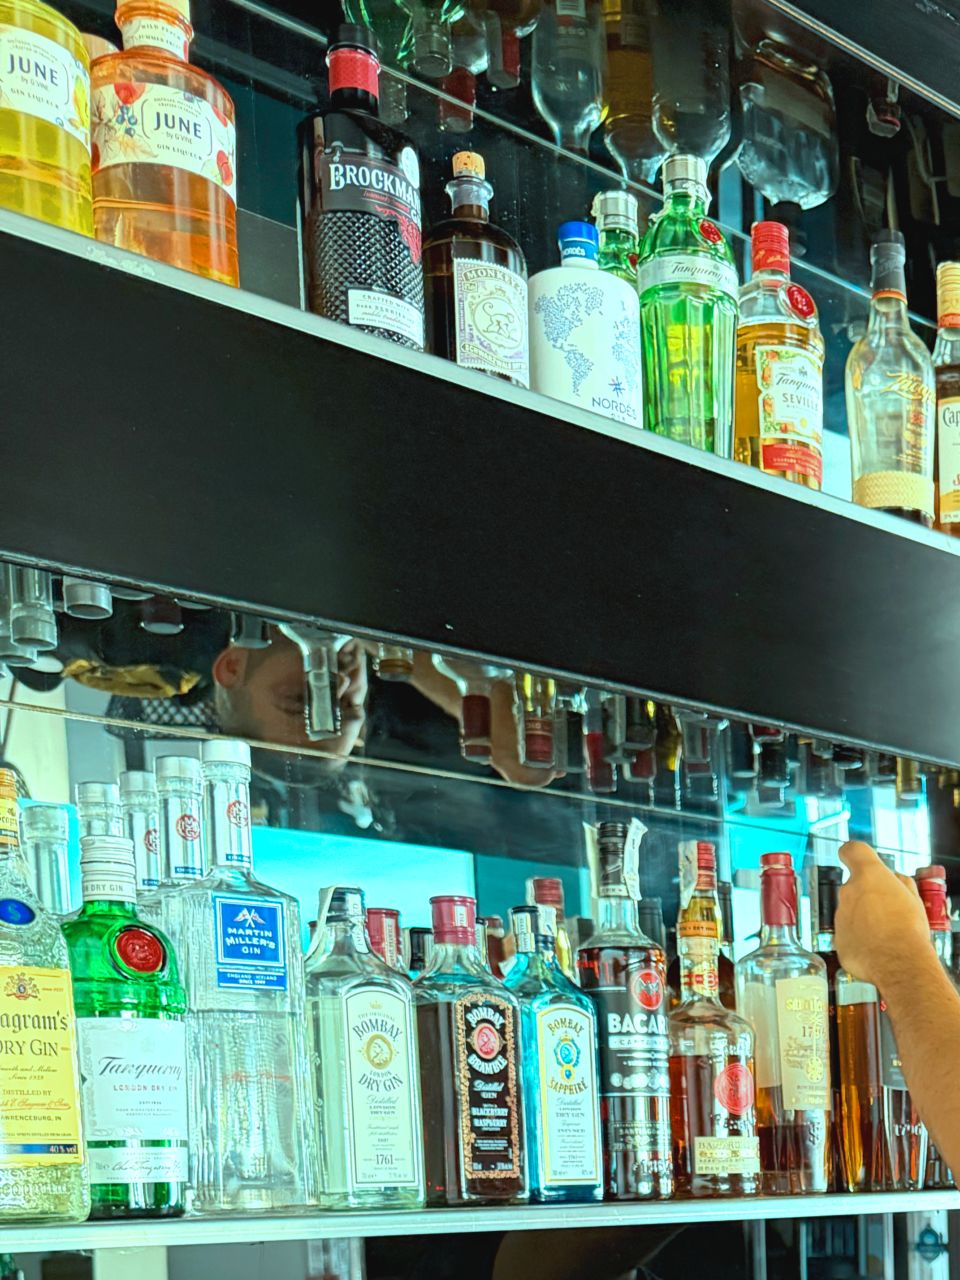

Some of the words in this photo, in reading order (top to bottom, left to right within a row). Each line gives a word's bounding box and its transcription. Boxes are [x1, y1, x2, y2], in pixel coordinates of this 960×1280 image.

[7, 53, 58, 87] JUNE
[154, 111, 202, 140] JUNE
[466, 268, 521, 293] MONKEY
[671, 261, 723, 283] Tanqueray
[363, 294, 393, 305] CRAFTED
[592, 397, 637, 420] NORDÉS
[91, 884, 106, 892] DRY
[109, 884, 124, 892] GIN
[227, 927, 273, 937] MARTIN
[225, 936, 276, 949] MILLER'S
[241, 946, 261, 955] GIN
[0, 1010, 69, 1034] agram's
[466, 1006, 506, 1030] BOMBAY
[547, 1017, 585, 1037] BOMBAY
[607, 1013, 668, 1034] BACAR
[352, 1018, 403, 1042] BOMBAY
[30, 1039, 60, 1057] GIN
[98, 1056, 183, 1081] Tanqueray
[467, 1053, 508, 1075] BRAMBLE
[358, 1073, 382, 1093] DRY
[383, 1073, 404, 1092] GIN
[369, 1070, 392, 1079] LONDON
[113, 1084, 148, 1092] LONDON
[151, 1084, 165, 1092] DRY
[480, 1091, 498, 1099] GIN
[547, 1076, 589, 1096] SAPPHIRE
[375, 1154, 394, 1165] 1761
